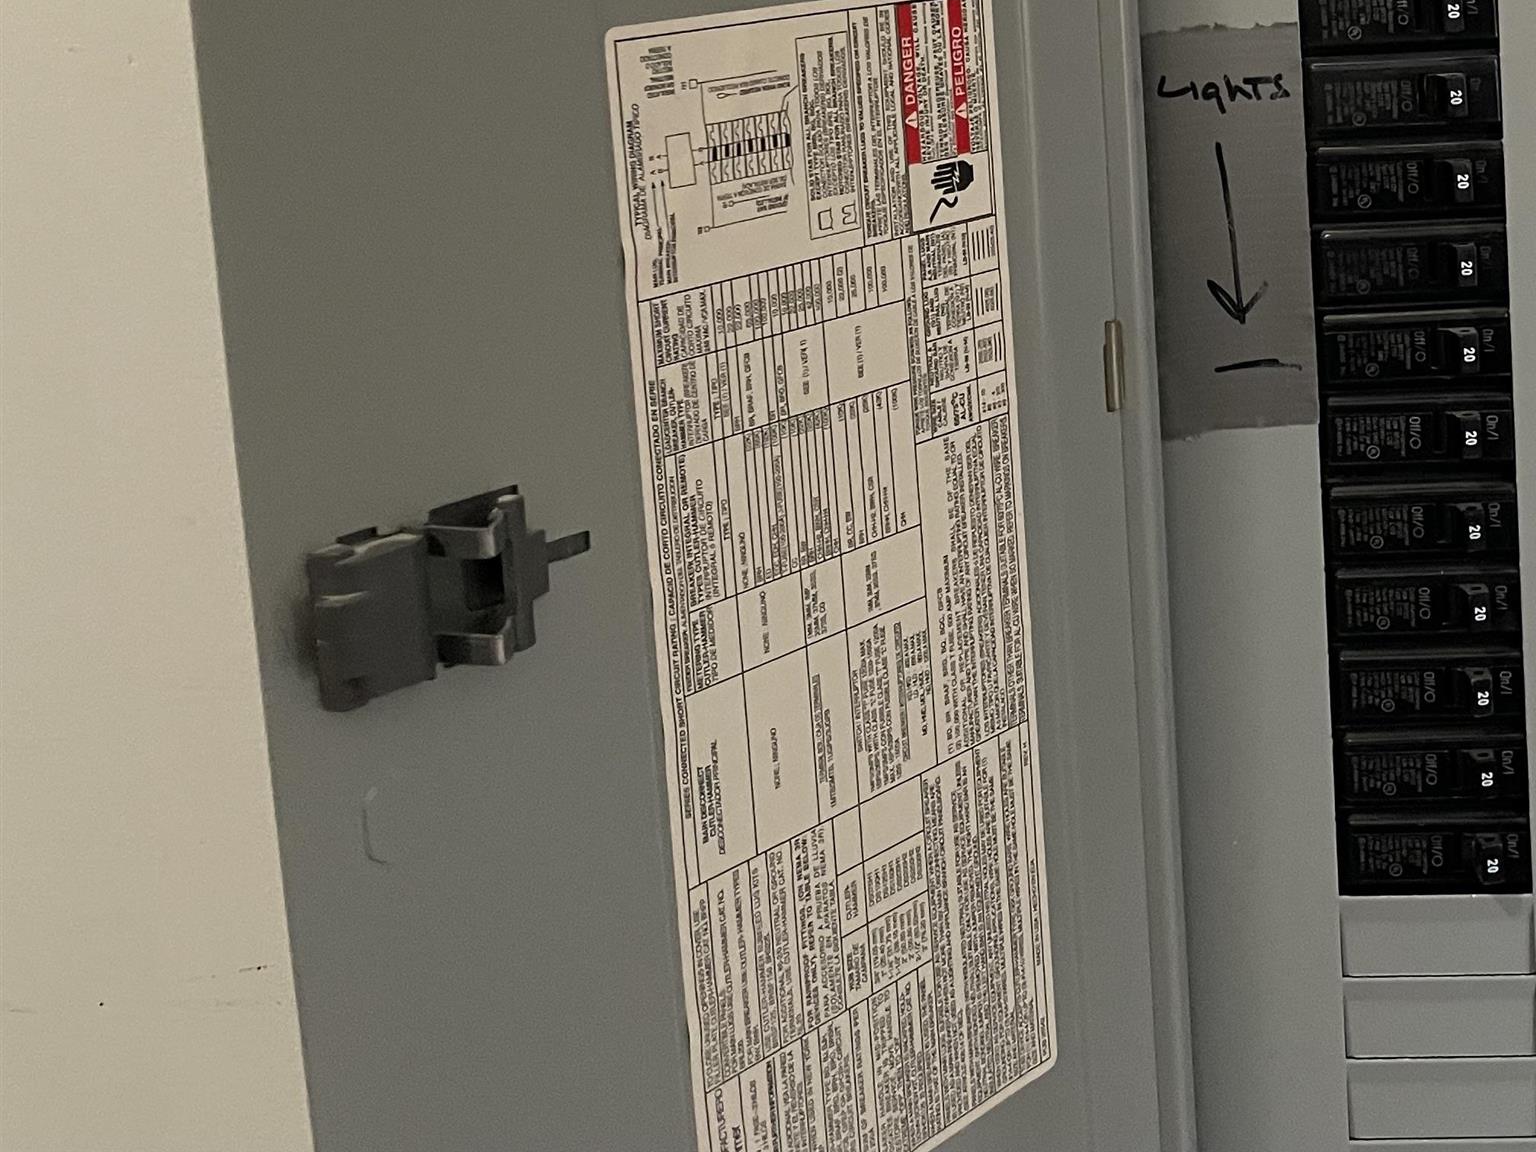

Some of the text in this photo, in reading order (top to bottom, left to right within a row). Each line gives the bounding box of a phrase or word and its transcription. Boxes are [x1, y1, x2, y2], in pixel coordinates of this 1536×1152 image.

[1448, 4, 1460, 18] 20
[951, 26, 966, 96] PELIGRO
[901, 36, 916, 105] DANGER
[1451, 90, 1462, 104] 20
[1458, 175, 1469, 188] 20
[1461, 262, 1472, 275] 20
[1464, 348, 1475, 362] 20
[1466, 431, 1477, 445] 20
[656, 484, 668, 526] CIRCUITO
[1469, 525, 1480, 539] 20
[661, 528, 671, 560] CORTO
[664, 562, 672, 575] DE
[1475, 607, 1486, 621] 20
[1478, 692, 1489, 705] 20
[1482, 772, 1493, 786] 20
[1488, 859, 1498, 873] 20
